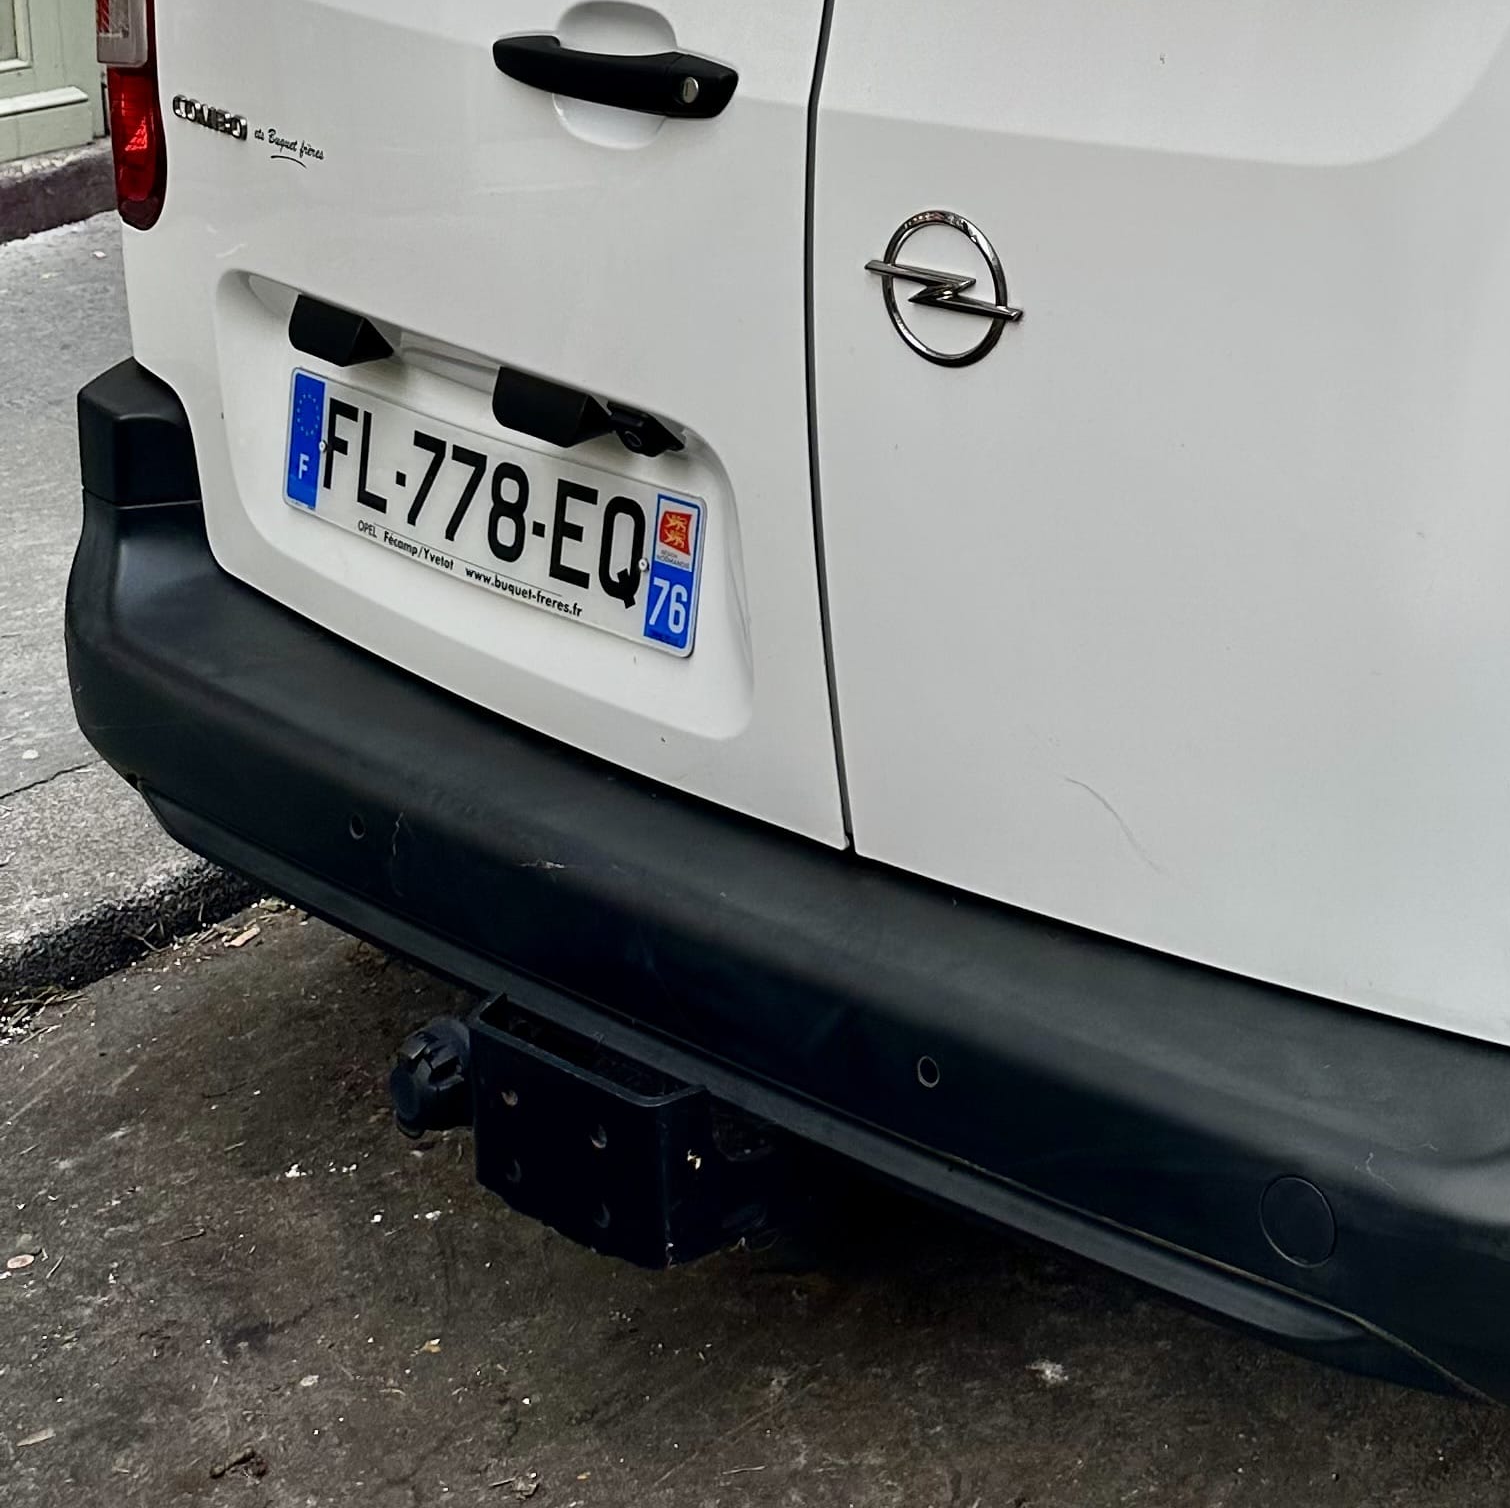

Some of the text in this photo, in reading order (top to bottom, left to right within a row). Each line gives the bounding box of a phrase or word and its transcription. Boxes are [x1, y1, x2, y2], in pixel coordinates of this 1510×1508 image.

[172, 94, 248, 141] COMBO
[268, 128, 298, 153] Buquet
[298, 453, 310, 480] F
[322, 396, 646, 610] FL-778-EQ
[357, 519, 583, 617] OPEL Fécamp/Yvetot www.buquet-freres.fr
[648, 576, 689, 634] 76
